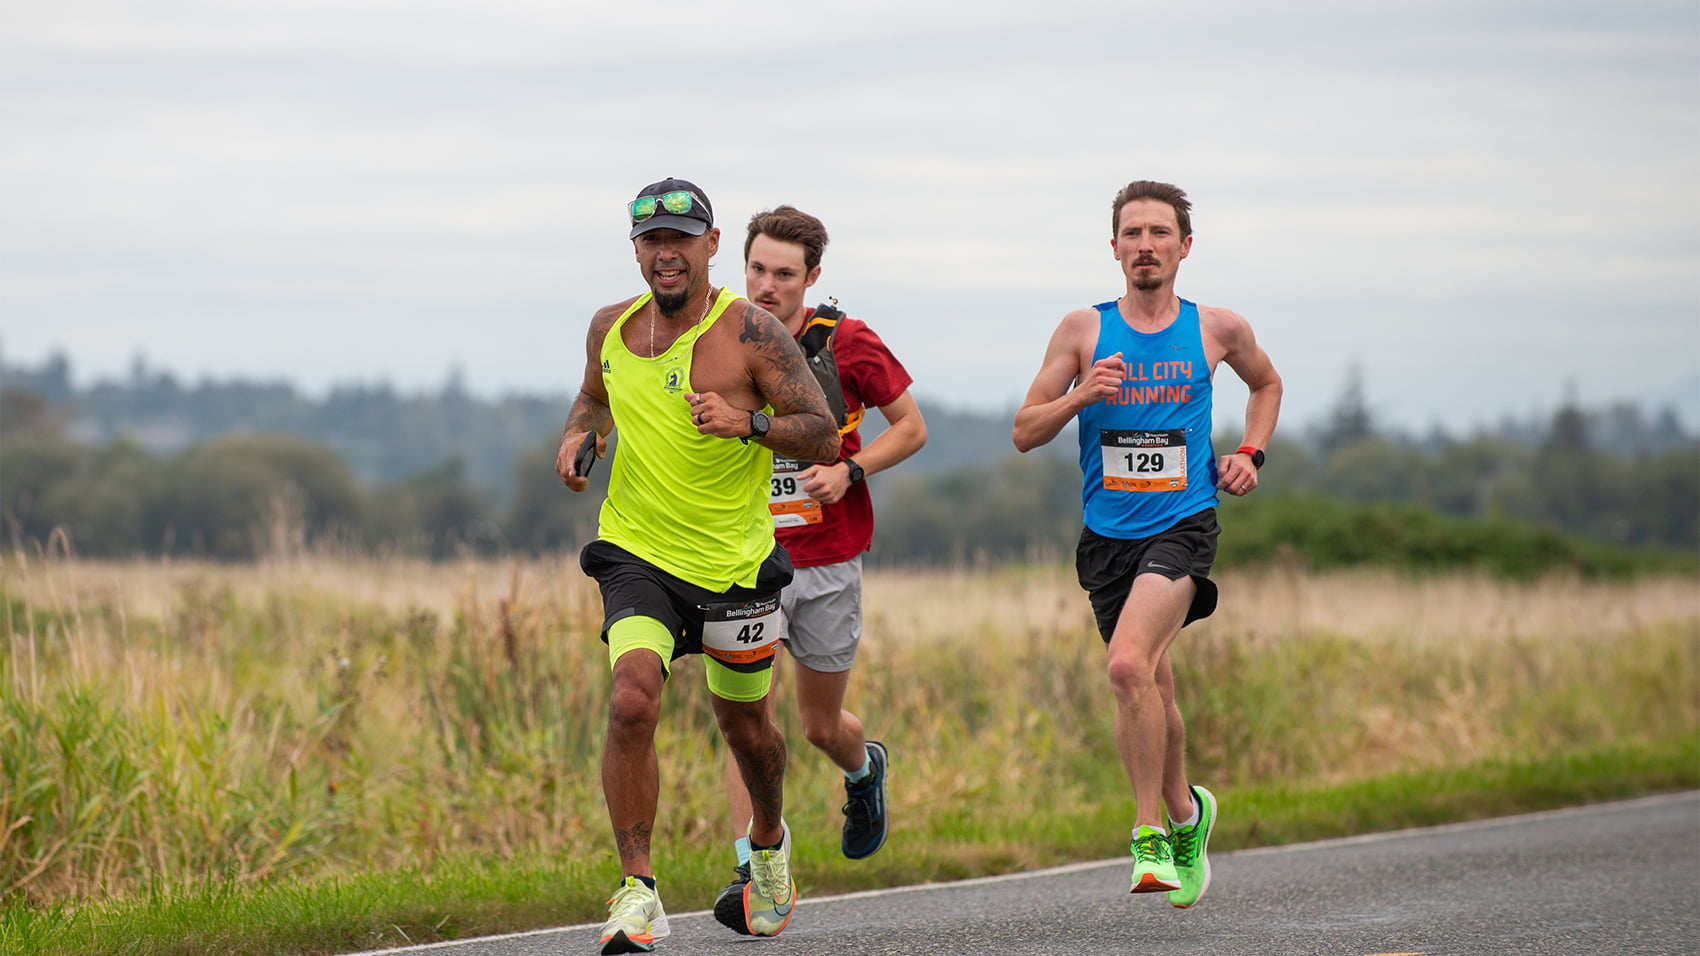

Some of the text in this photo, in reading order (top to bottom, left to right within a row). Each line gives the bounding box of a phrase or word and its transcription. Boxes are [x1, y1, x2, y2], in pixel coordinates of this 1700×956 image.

[1122, 361, 1192, 381] ILL CITY
[1105, 385, 1191, 405] RUNNING
[1118, 436, 1155, 446] Bellingham
[1156, 437, 1169, 446] Bay
[1124, 452, 1164, 472] 129
[726, 606, 765, 617] Bellingham
[765, 602, 776, 611] Bay
[736, 622, 764, 644] 42
